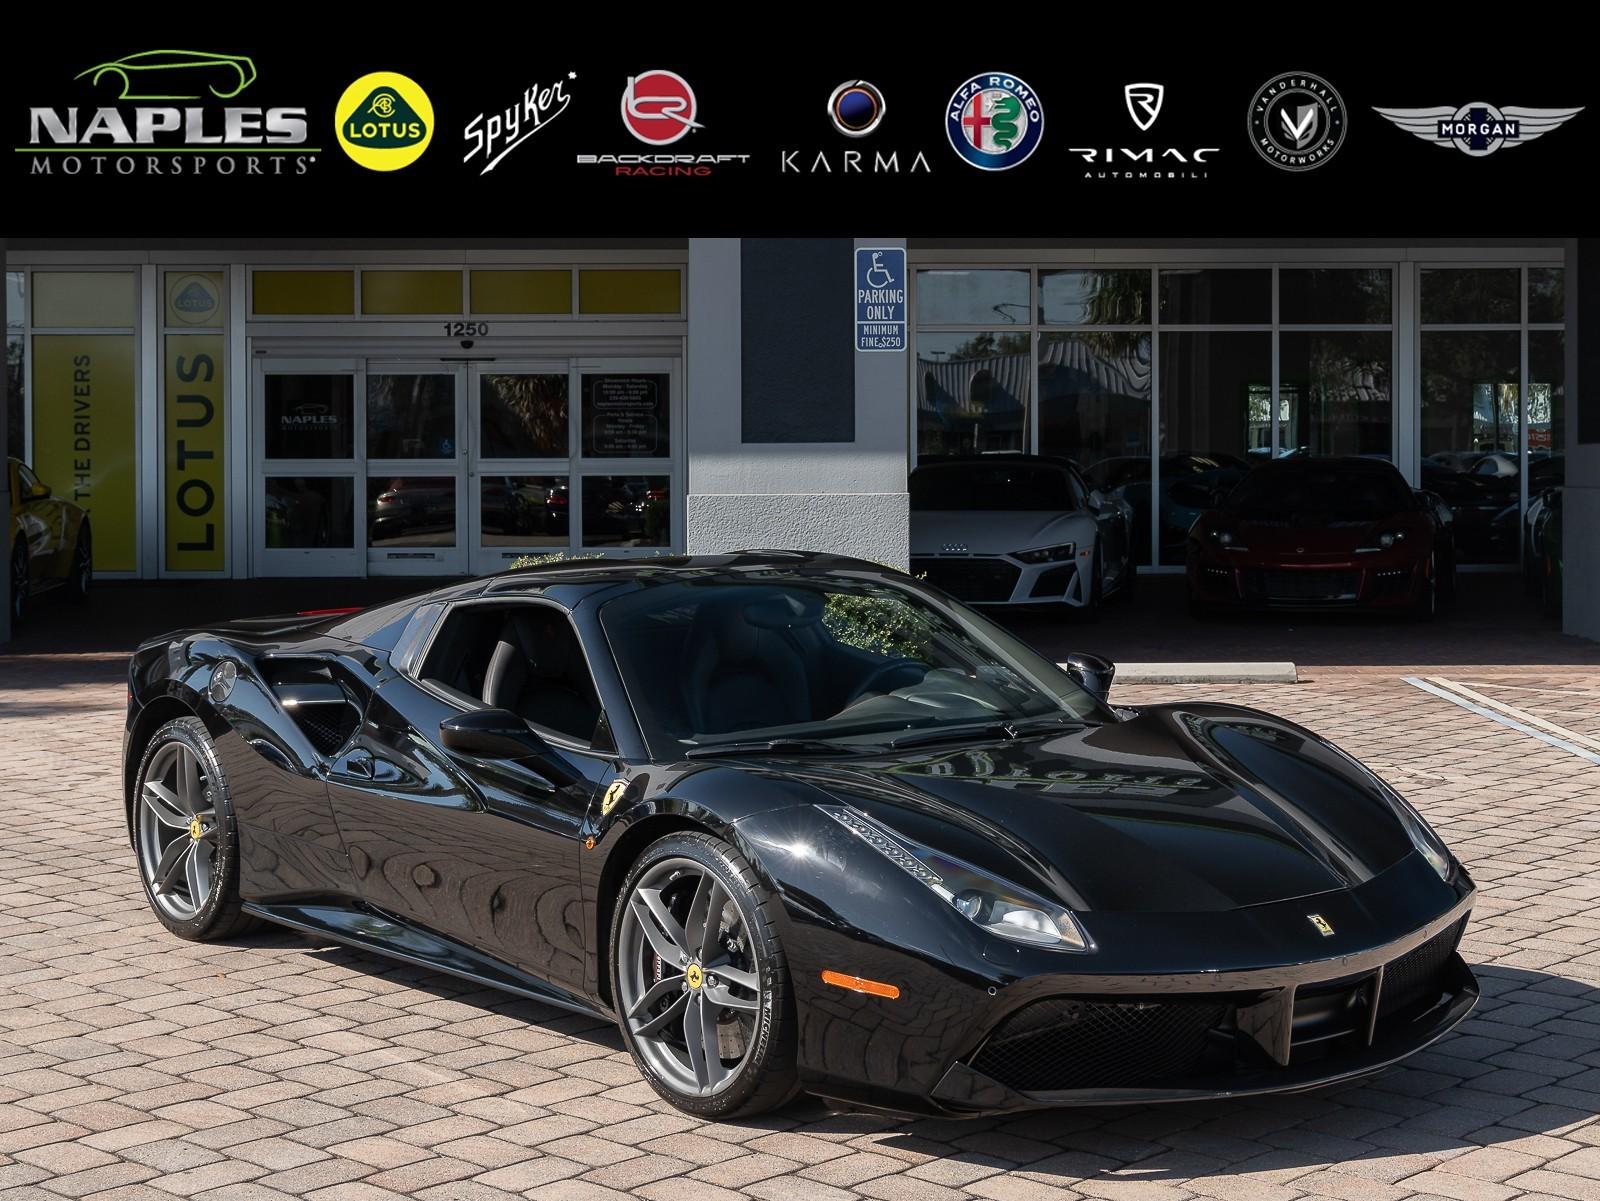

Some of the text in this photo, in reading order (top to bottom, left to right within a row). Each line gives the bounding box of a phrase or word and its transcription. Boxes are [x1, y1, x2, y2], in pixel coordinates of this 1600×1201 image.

[858, 289, 904, 304] PARKING
[866, 305, 895, 320] ONLY
[443, 321, 489, 337] 1250
[863, 325, 899, 335] MINIMUM
[861, 336, 901, 348] FINE $250
[74, 354, 91, 501] THE DRIVERS
[281, 415, 337, 425] NAPLES
[176, 353, 215, 552] LOTUS
